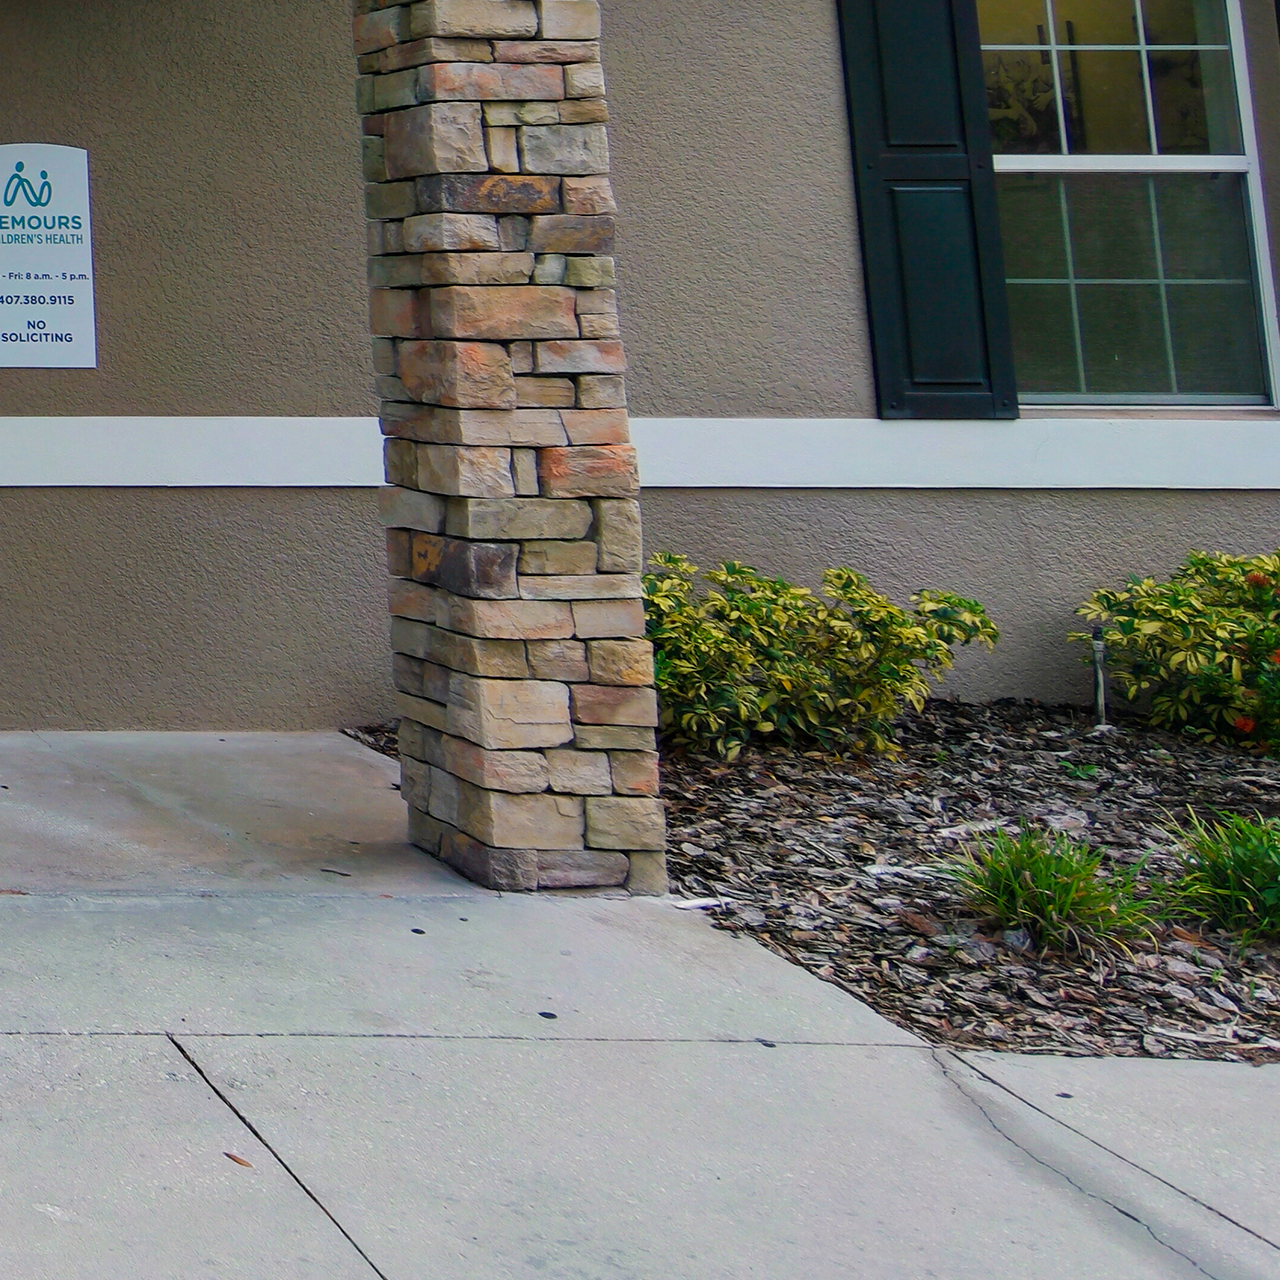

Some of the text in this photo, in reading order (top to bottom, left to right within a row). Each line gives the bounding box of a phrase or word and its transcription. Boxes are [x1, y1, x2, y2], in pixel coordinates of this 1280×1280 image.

[45, 233, 83, 245] HEALTH
[8, 272, 24, 280] Fri:
[26, 272, 32, 280] 8
[62, 272, 67, 280] 5
[27, 320, 47, 330] NO
[1, 332, 73, 343] SOLICITING
